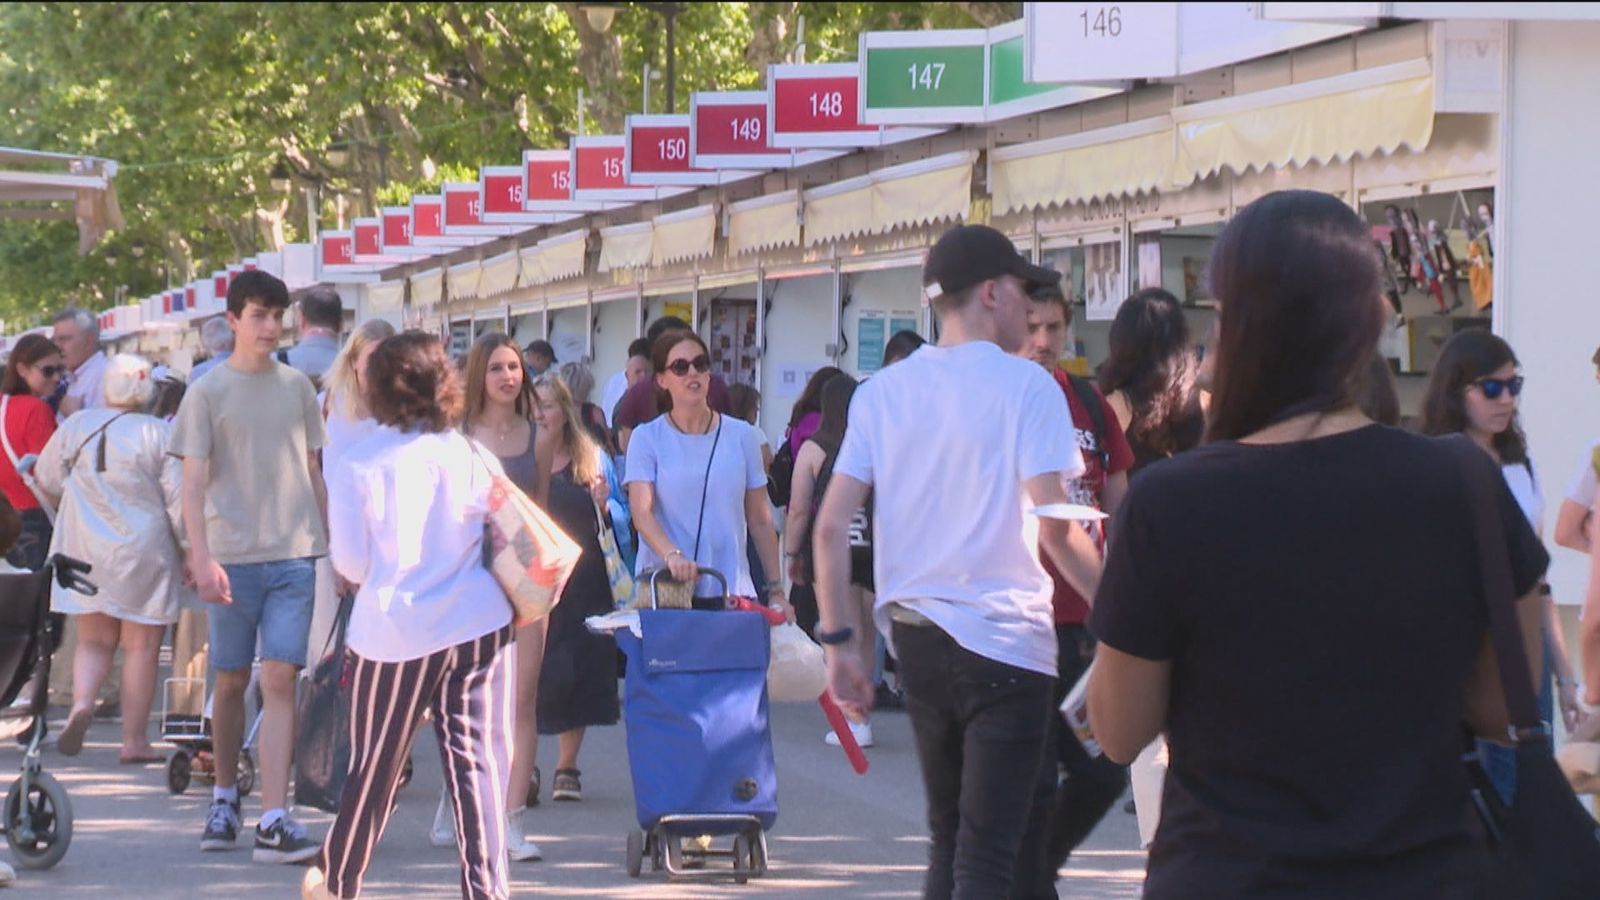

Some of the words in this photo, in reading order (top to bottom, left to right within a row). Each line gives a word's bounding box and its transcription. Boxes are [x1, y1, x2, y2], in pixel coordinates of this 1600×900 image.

[1080, 6, 1122, 38] 146
[908, 63, 946, 90] 147
[809, 92, 843, 118] 148
[730, 117, 761, 141] 149
[658, 138, 686, 160] 150
[507, 184, 523, 204] 15
